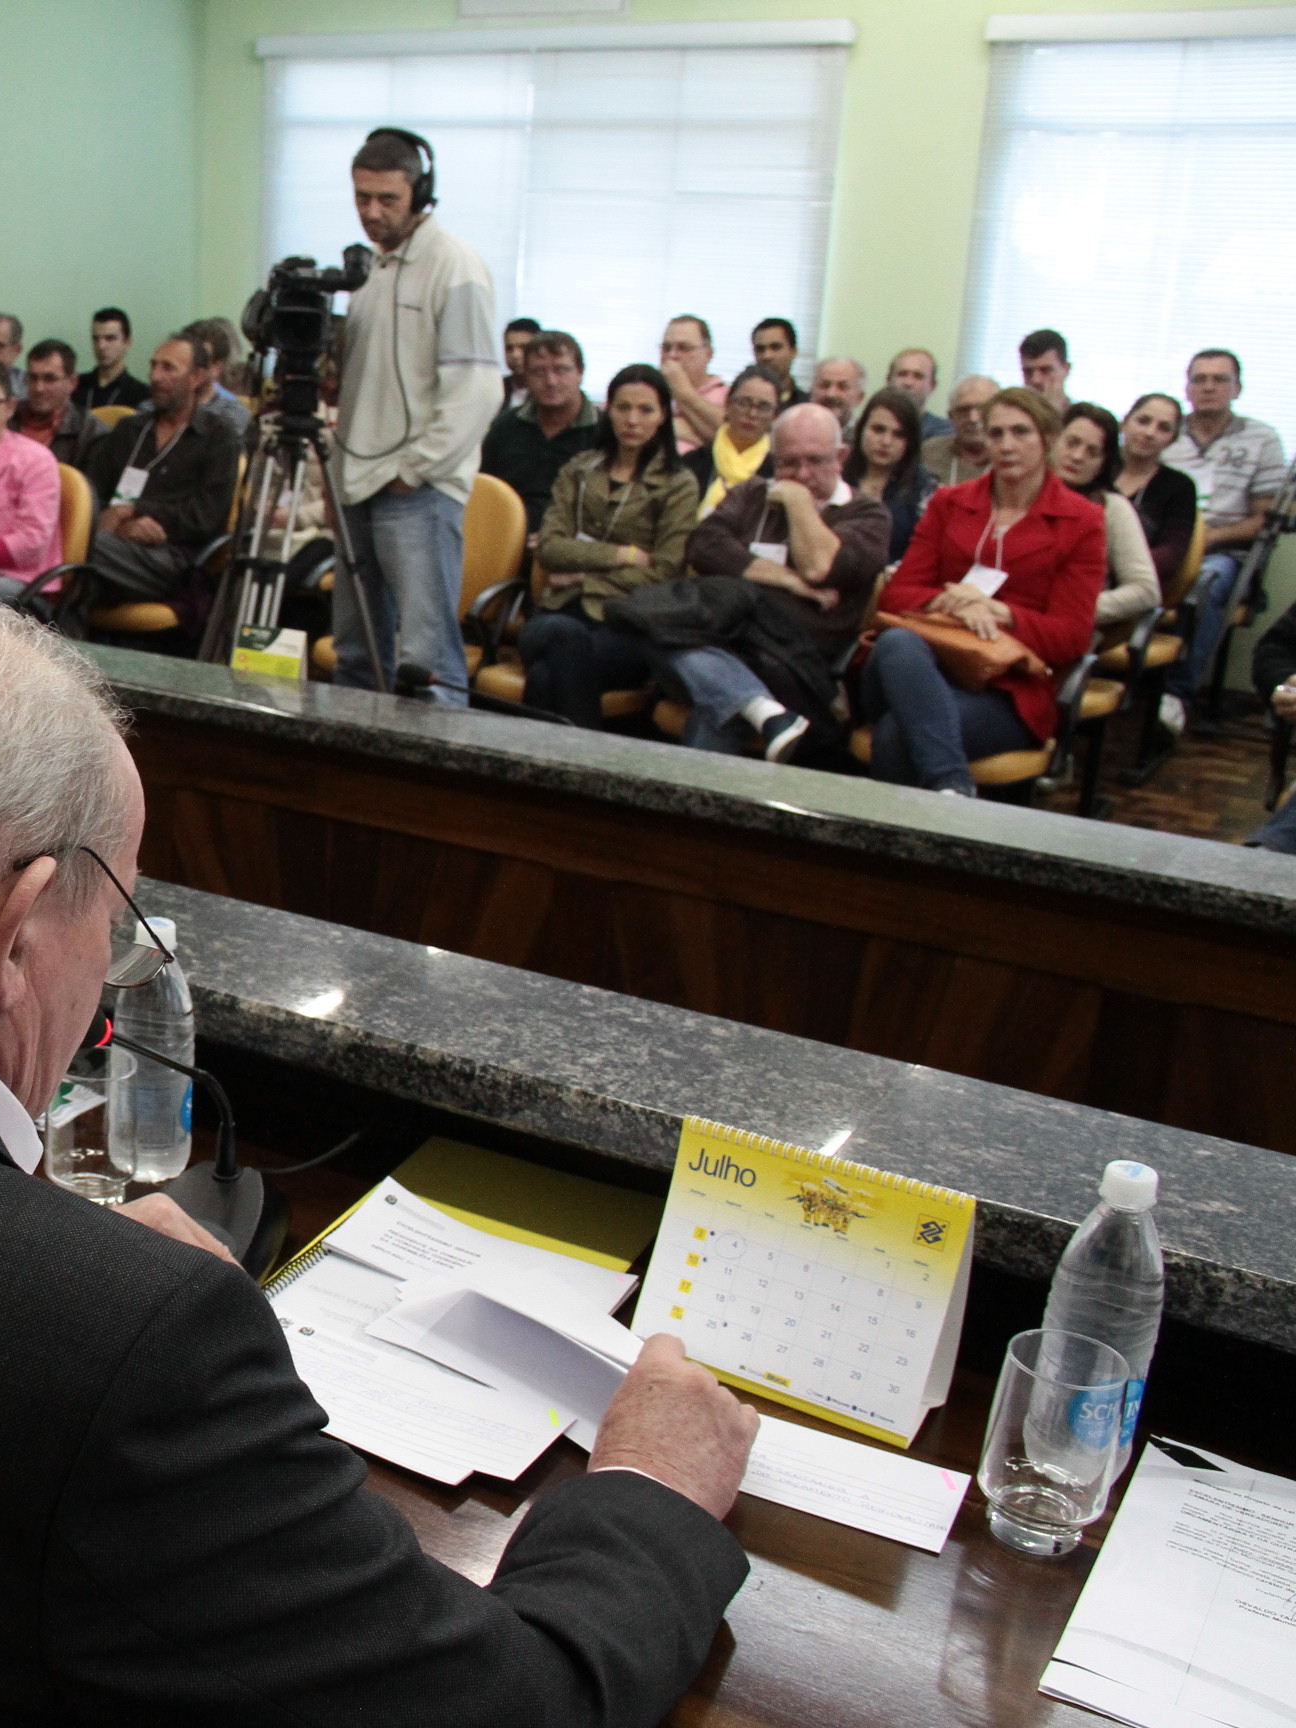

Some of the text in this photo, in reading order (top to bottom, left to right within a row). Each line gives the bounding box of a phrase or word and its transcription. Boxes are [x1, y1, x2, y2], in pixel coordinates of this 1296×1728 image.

[688, 1148, 757, 1187] Julho
[724, 1267, 733, 1275] 11
[758, 1278, 768, 1288] 12
[794, 1291, 804, 1300] 13
[831, 1303, 841, 1313] 14
[867, 1316, 878, 1326] 15
[905, 1328, 916, 1339] 16
[767, 1252, 774, 1261] 5
[803, 1264, 810, 1273] 6
[841, 1276, 847, 1284] 7
[877, 1288, 884, 1297] 8
[915, 1301, 922, 1310] 9
[885, 1261, 929, 1282] 1 2
[706, 1319, 900, 1394] 25 26 27 28 29 30
[715, 1293, 725, 1303] 18
[751, 1306, 761, 1315] 19
[785, 1318, 796, 1328] 20
[821, 1330, 832, 1340] 21
[858, 1343, 870, 1354] 22
[896, 1356, 908, 1366] 23
